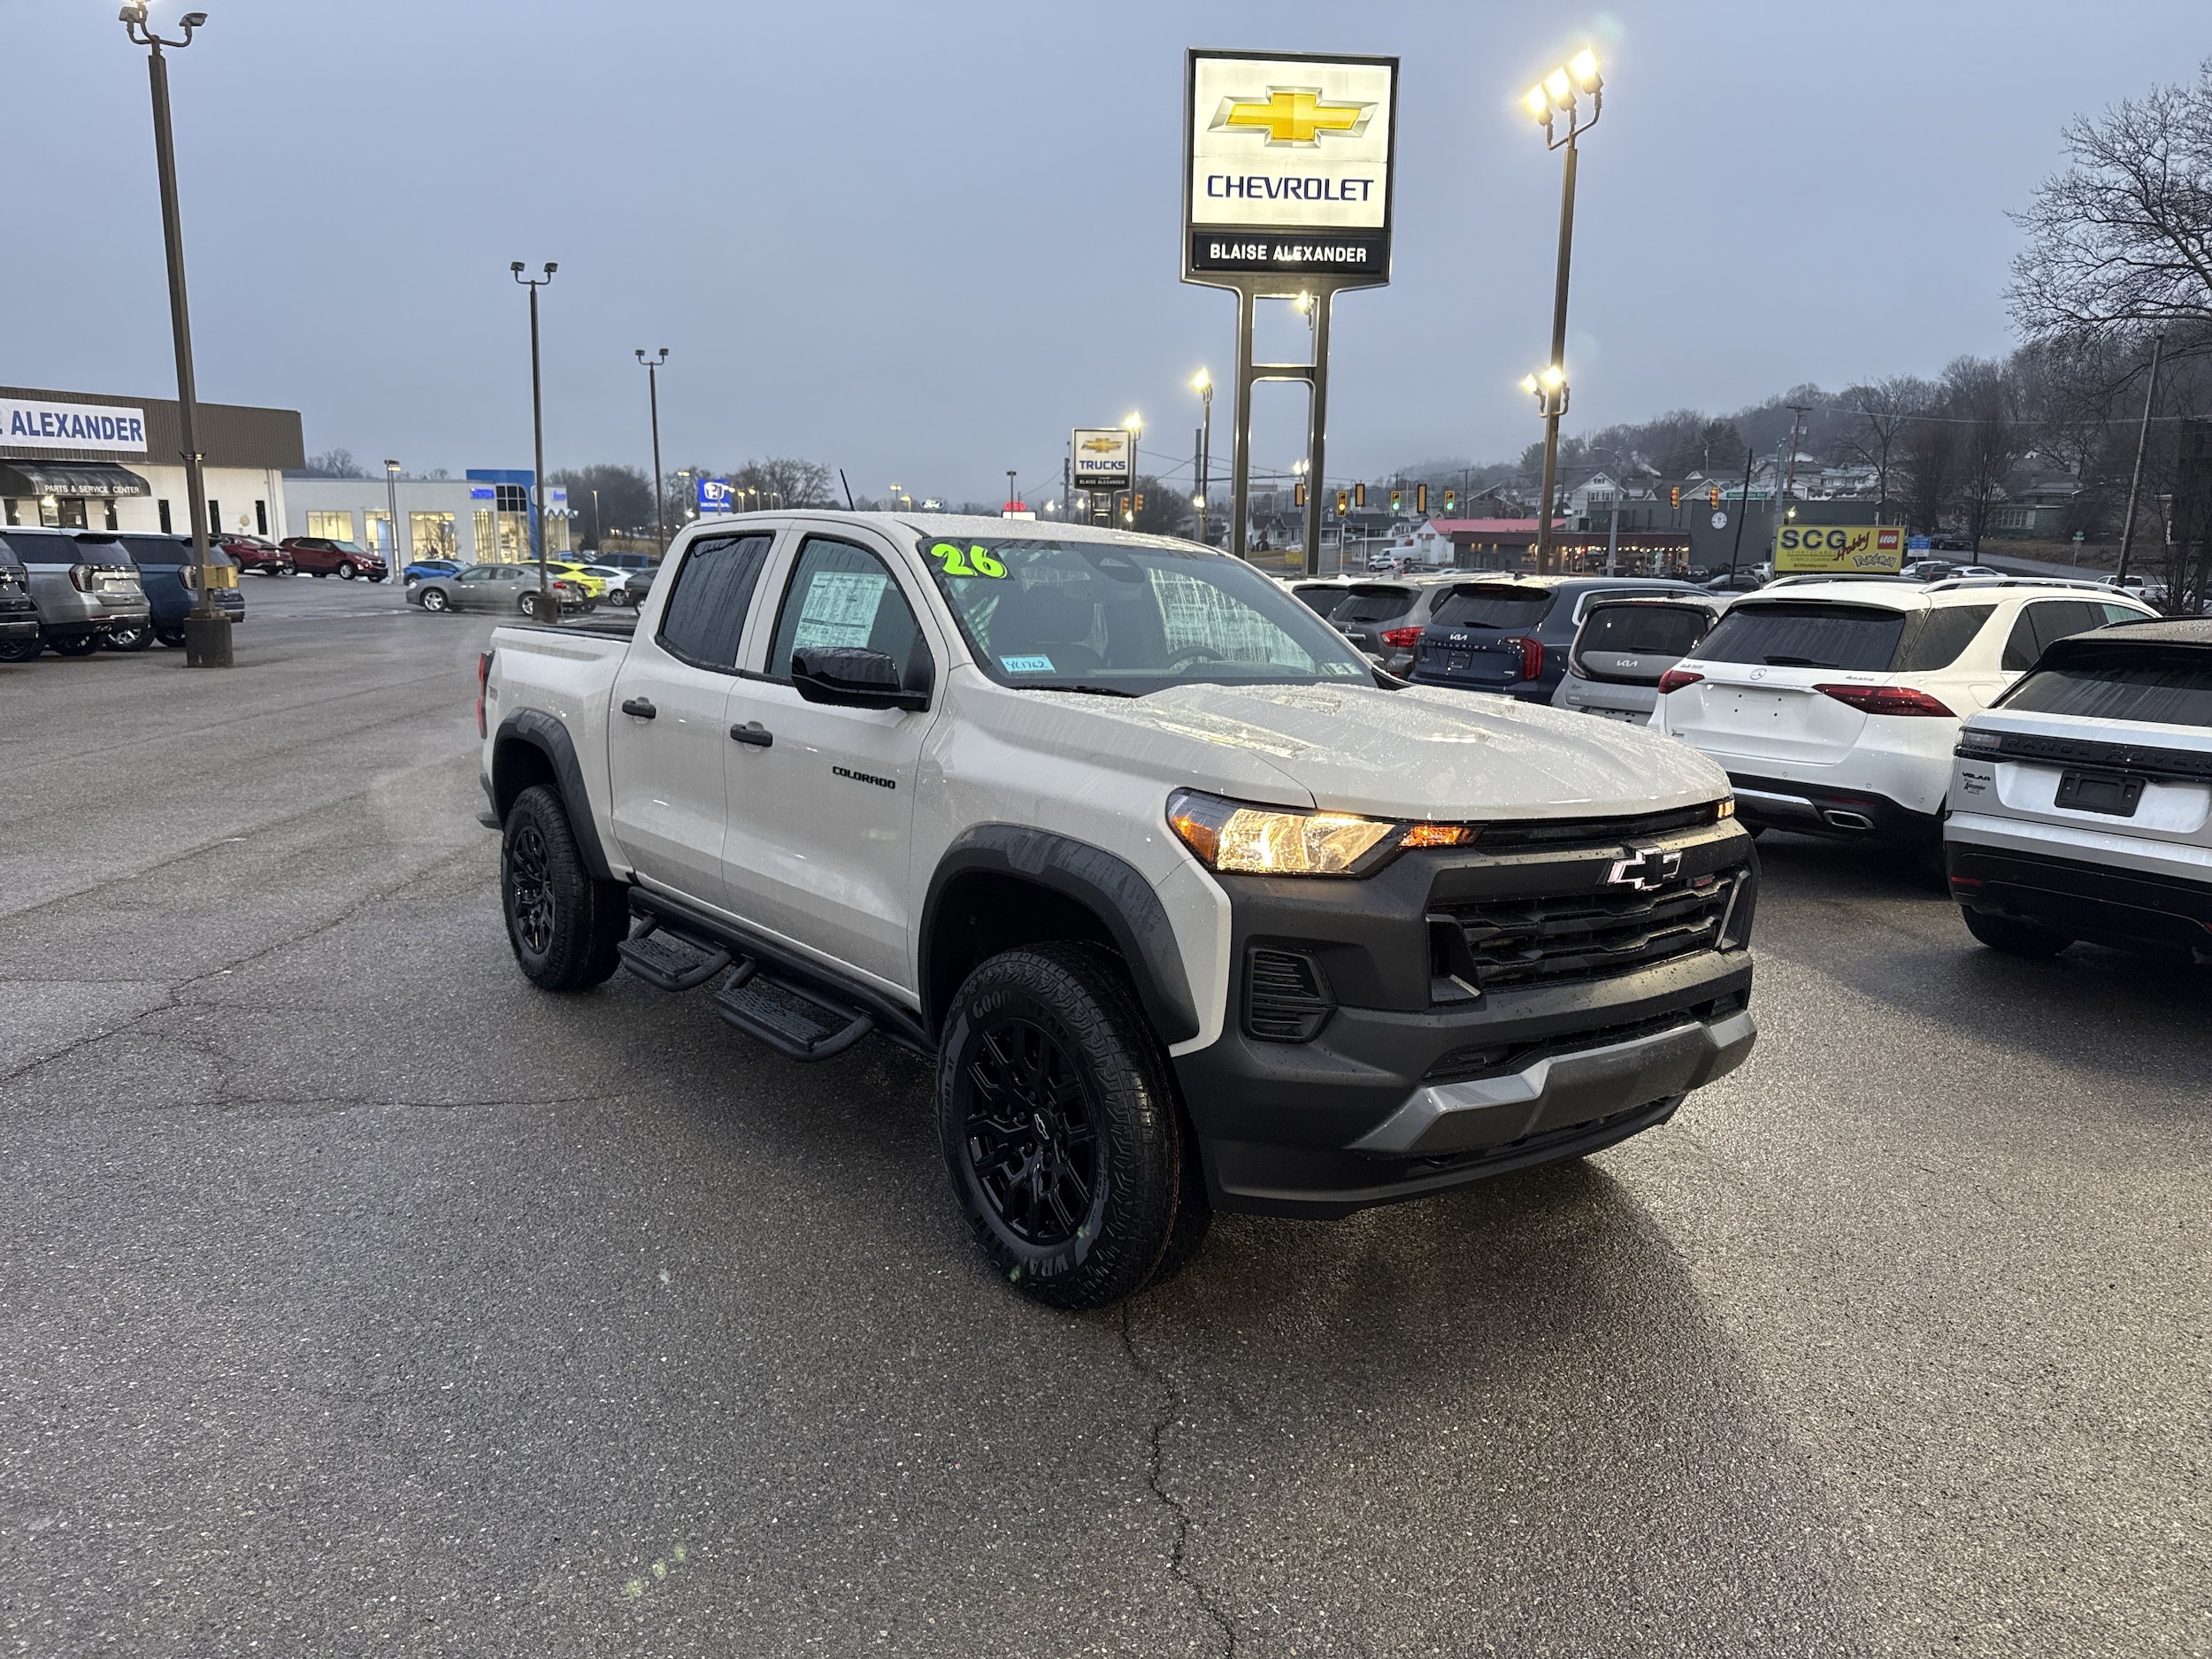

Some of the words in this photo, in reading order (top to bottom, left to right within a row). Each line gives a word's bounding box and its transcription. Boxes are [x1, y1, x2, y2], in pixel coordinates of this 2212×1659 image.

[1207, 174, 1374, 202] CHEVROLET
[1210, 243, 1268, 261] BLAISE
[1272, 245, 1368, 264] ALEXANDER
[11, 410, 144, 442] ALEXANDER
[1079, 460, 1126, 470] TRUCKS
[44, 484, 69, 493] PARTS
[78, 485, 109, 494] SERVICE
[1780, 529, 1847, 550] SCG
[1832, 531, 1870, 561] Hobby
[1879, 535, 1897, 544] LEGO
[931, 543, 1008, 579] 26
[2007, 739, 2092, 756] RANGE
[2106, 746, 2212, 769] ROVER
[833, 765, 895, 789] COLORADO
[1962, 772, 1991, 781] VELAR
